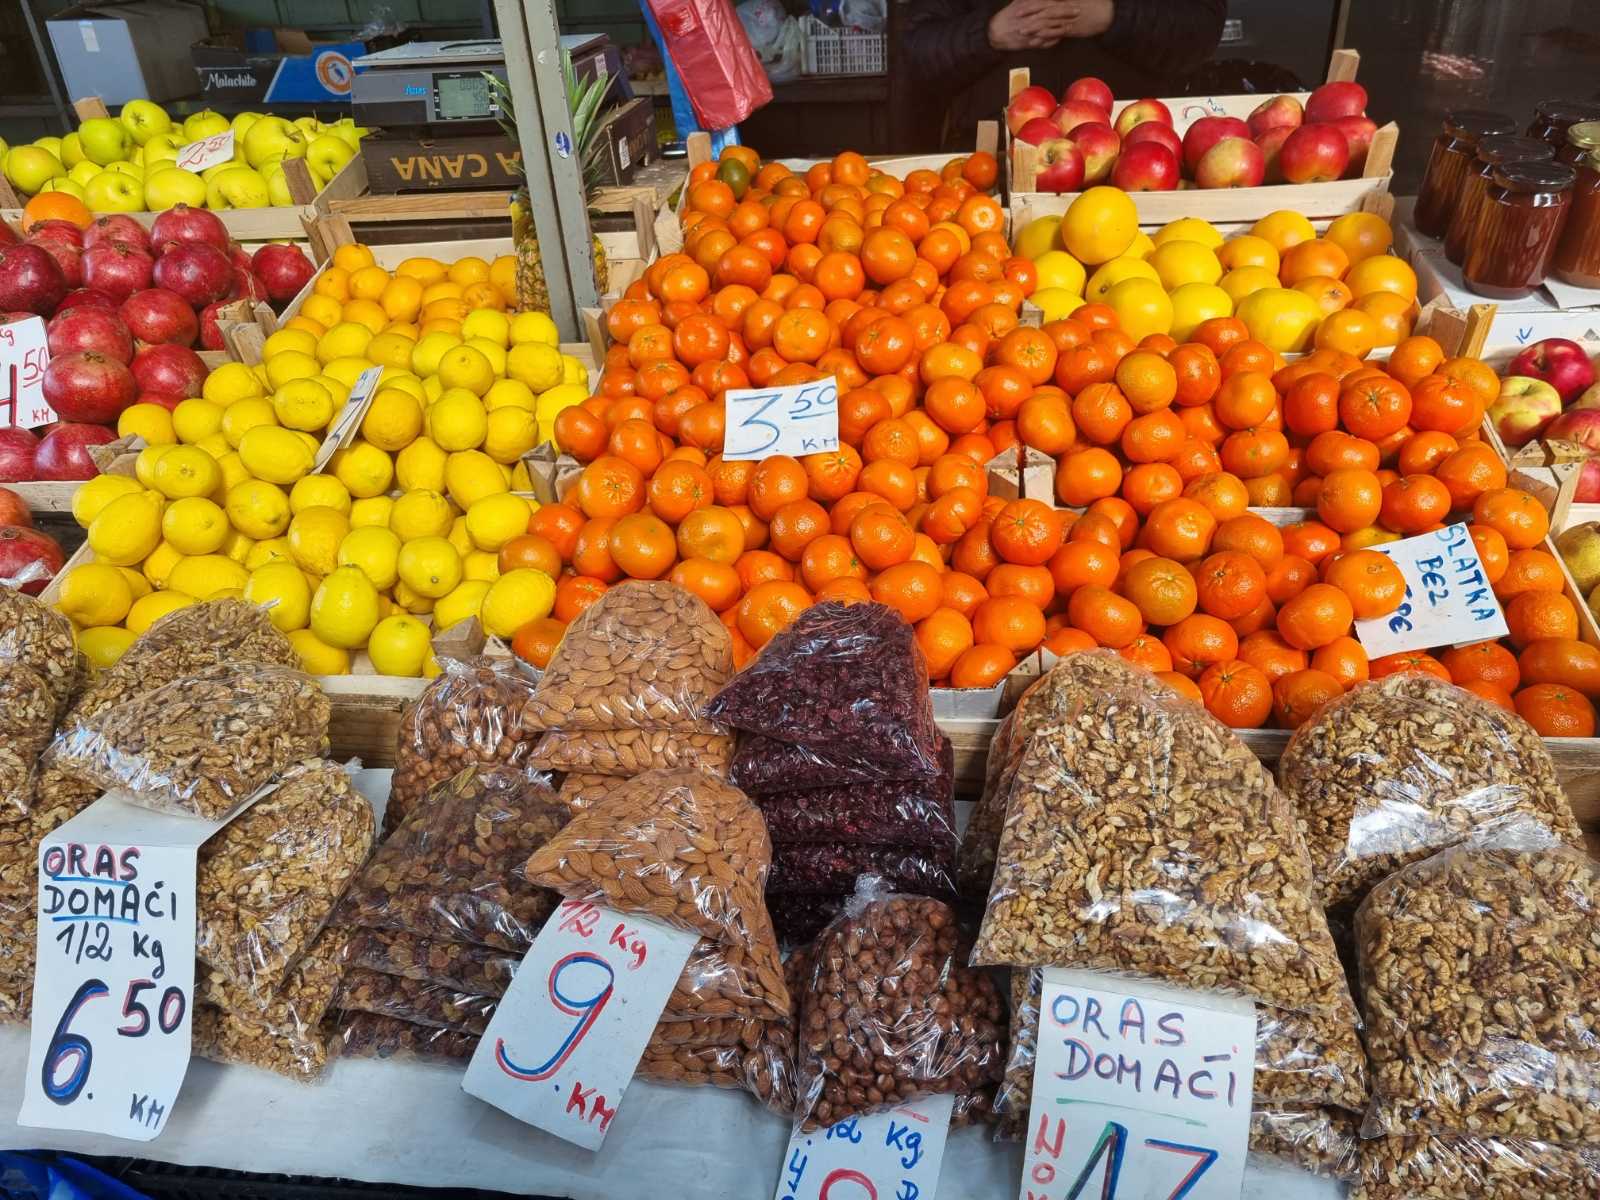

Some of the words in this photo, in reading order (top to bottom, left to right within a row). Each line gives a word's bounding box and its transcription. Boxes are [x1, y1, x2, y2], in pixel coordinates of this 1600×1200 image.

[1435, 524, 1496, 622] SLATKA
[43, 842, 141, 882] ORAS
[56, 922, 112, 964] 1/2
[1051, 995, 1186, 1047] ORAS
[129, 1093, 165, 1130] KM
[566, 1081, 615, 1133] KM
